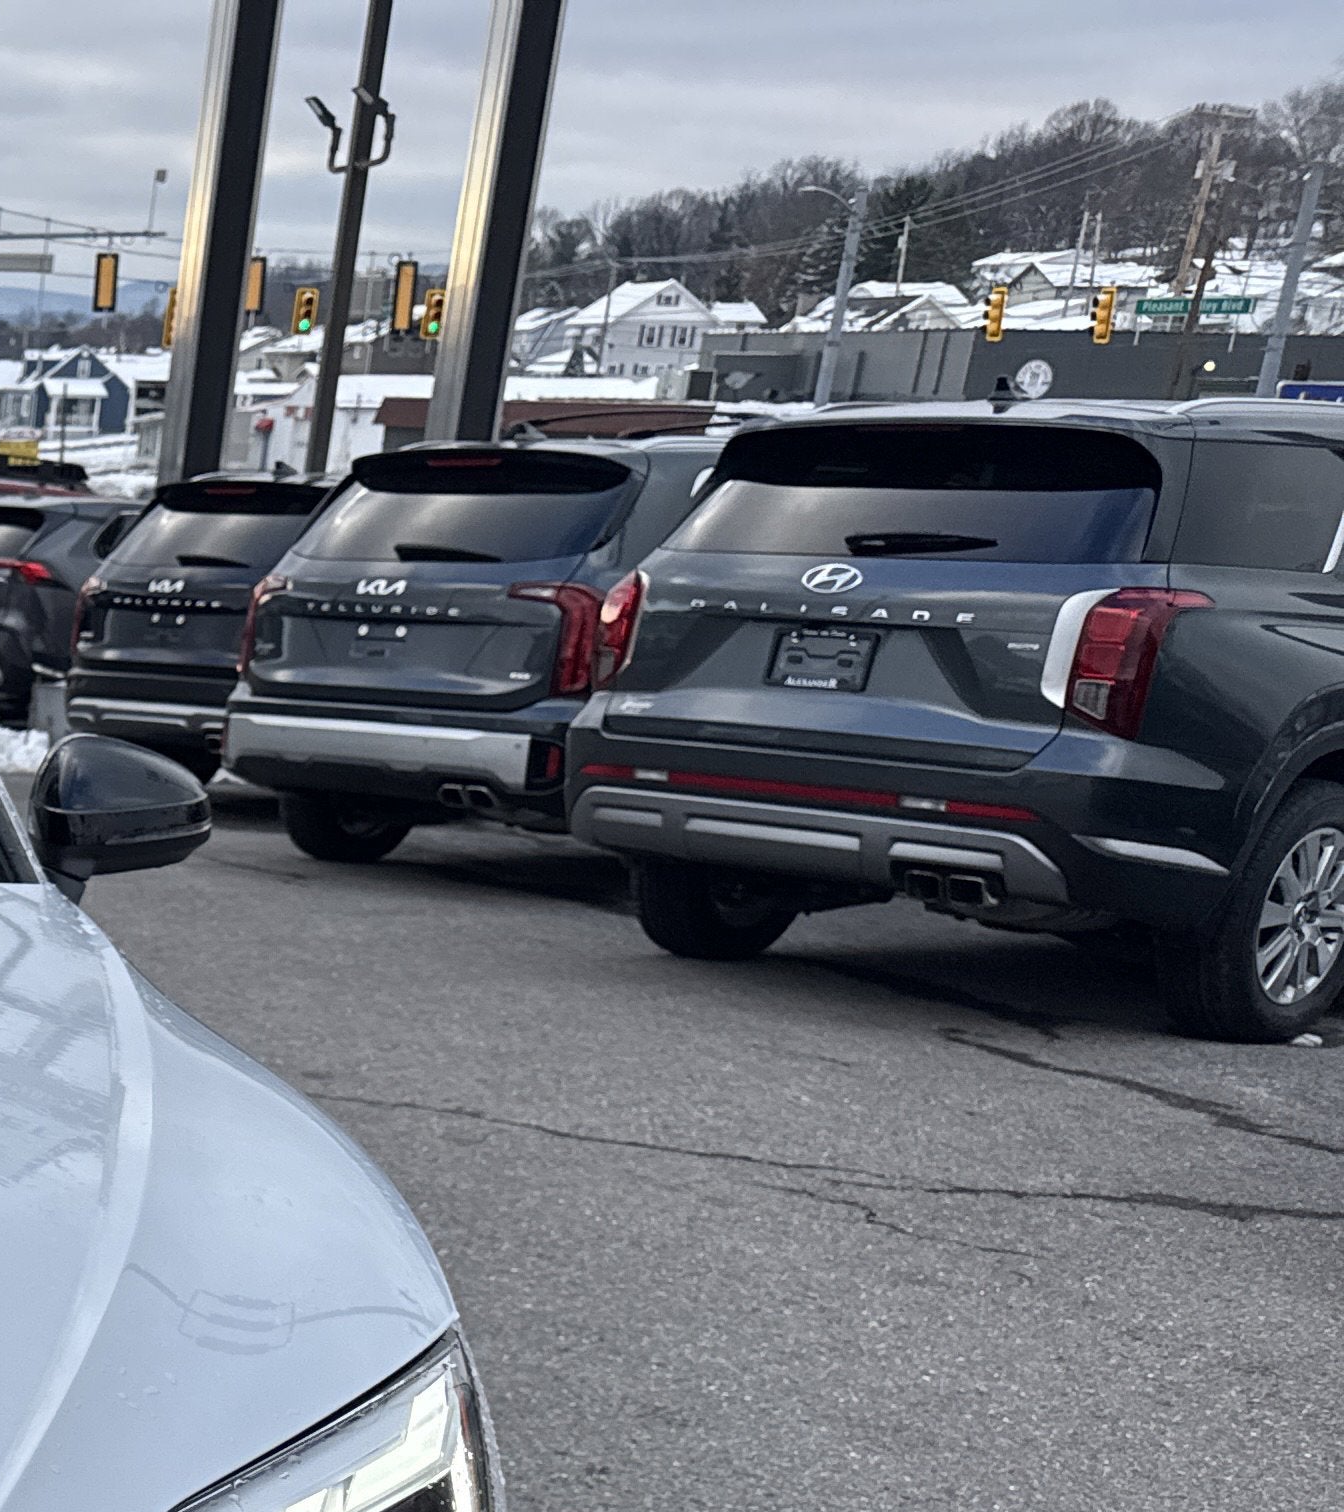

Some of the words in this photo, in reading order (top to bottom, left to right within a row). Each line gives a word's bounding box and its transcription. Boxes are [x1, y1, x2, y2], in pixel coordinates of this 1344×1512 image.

[1142, 300, 1185, 312] Pleasant
[1220, 299, 1246, 311] Blvd
[306, 601, 461, 617] TELLURIDE
[690, 598, 976, 624] PALISADE
[783, 675, 839, 690] ALEXANDER
